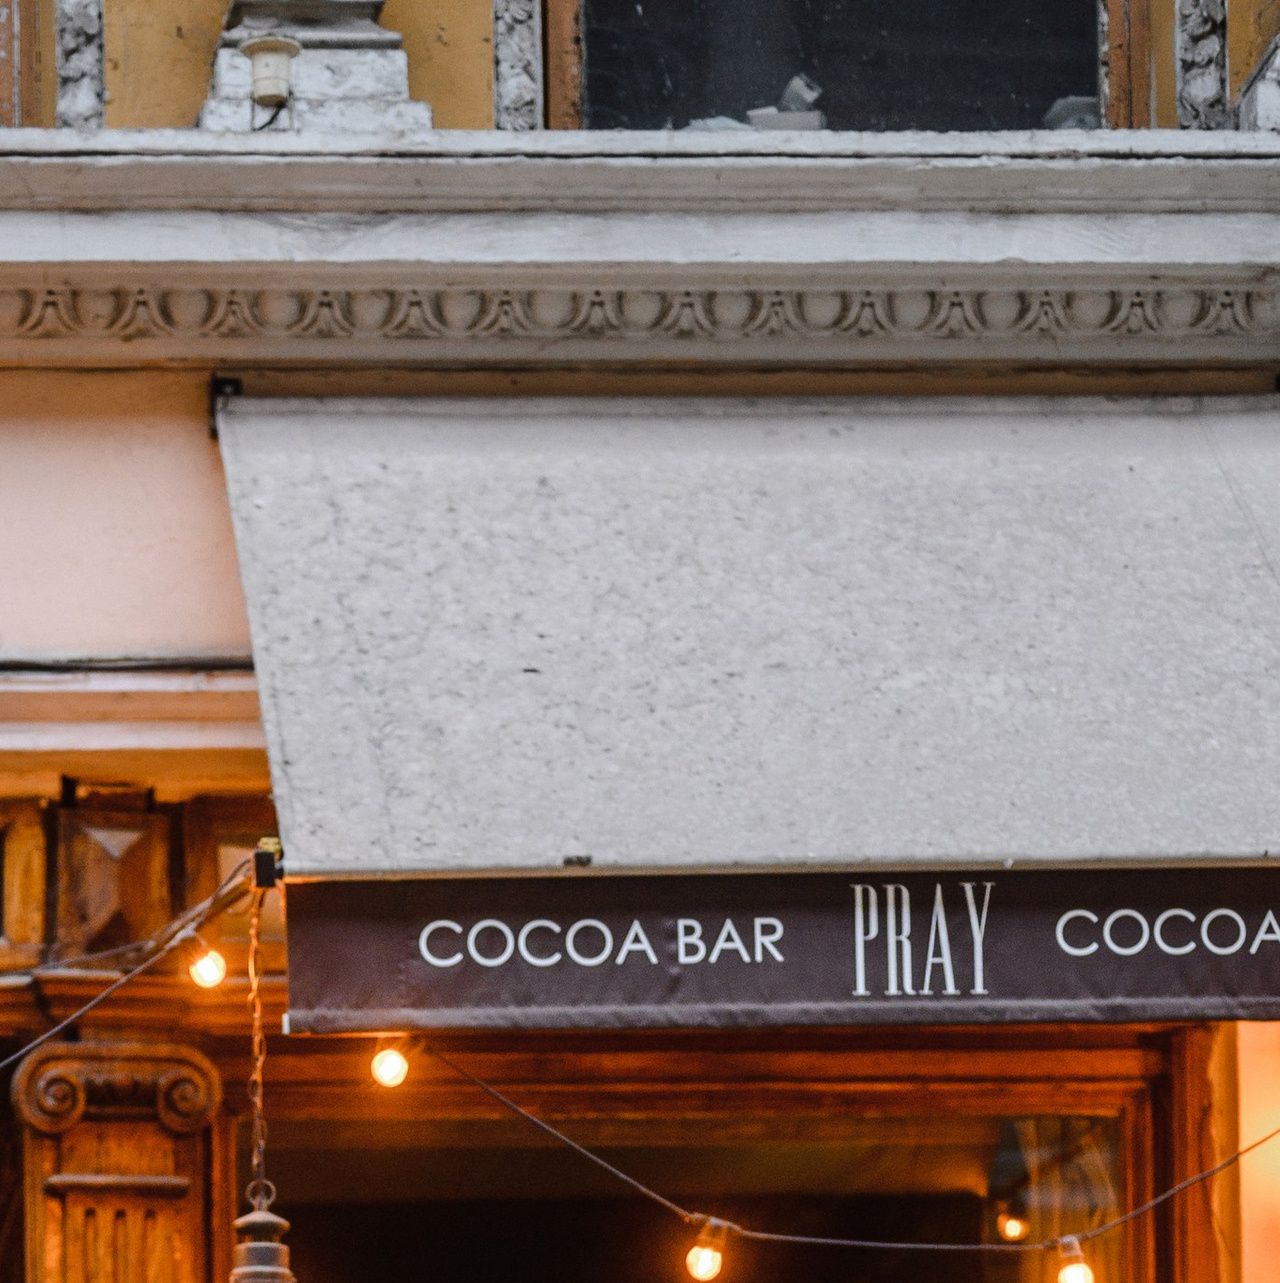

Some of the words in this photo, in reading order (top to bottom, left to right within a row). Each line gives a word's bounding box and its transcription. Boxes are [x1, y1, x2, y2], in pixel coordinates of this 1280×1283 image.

[418, 918, 660, 968] COCOA
[677, 917, 785, 965] BAR
[849, 881, 996, 996] PRAY
[1055, 908, 1280, 957] COCOA
